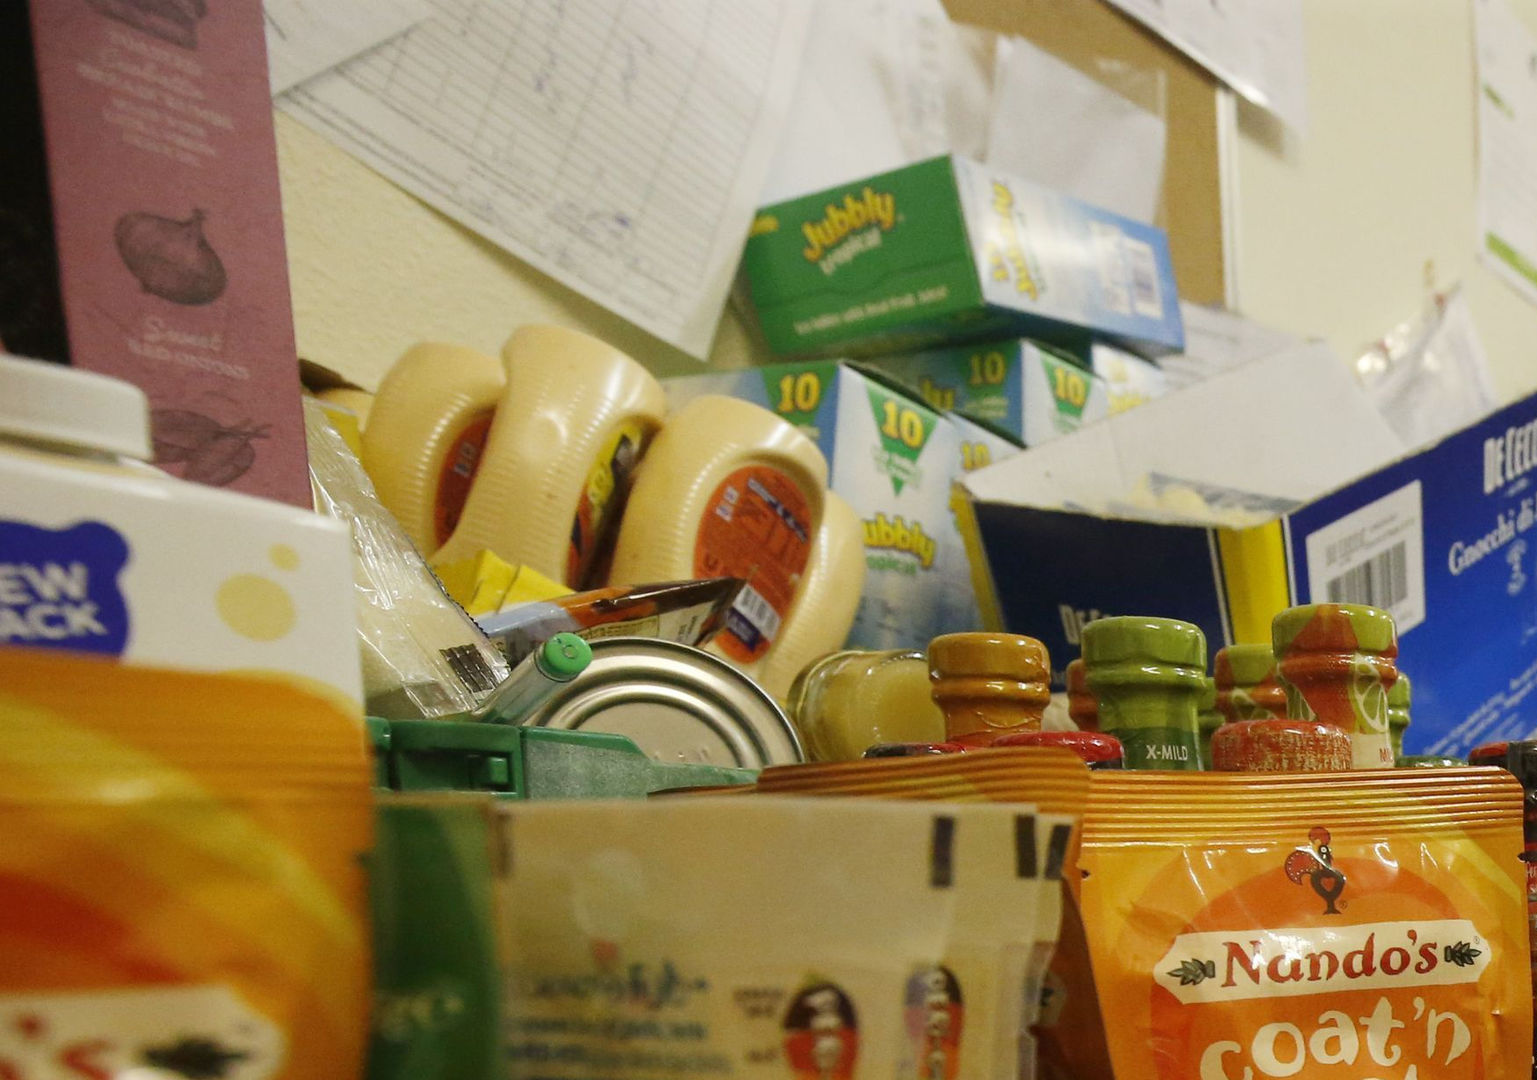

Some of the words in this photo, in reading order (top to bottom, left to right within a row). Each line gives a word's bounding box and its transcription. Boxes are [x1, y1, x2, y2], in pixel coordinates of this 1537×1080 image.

[802, 186, 895, 263] Jubbly
[966, 351, 1005, 386] 10
[1054, 364, 1087, 407] 10
[779, 371, 820, 413] 10
[883, 399, 924, 448] 10
[961, 440, 991, 470] 10
[862, 512, 936, 569] ubbly
[1449, 508, 1516, 576] Gnocchi
[1146, 744, 1189, 761] X-MILD
[1221, 930, 1438, 988] Nando's
